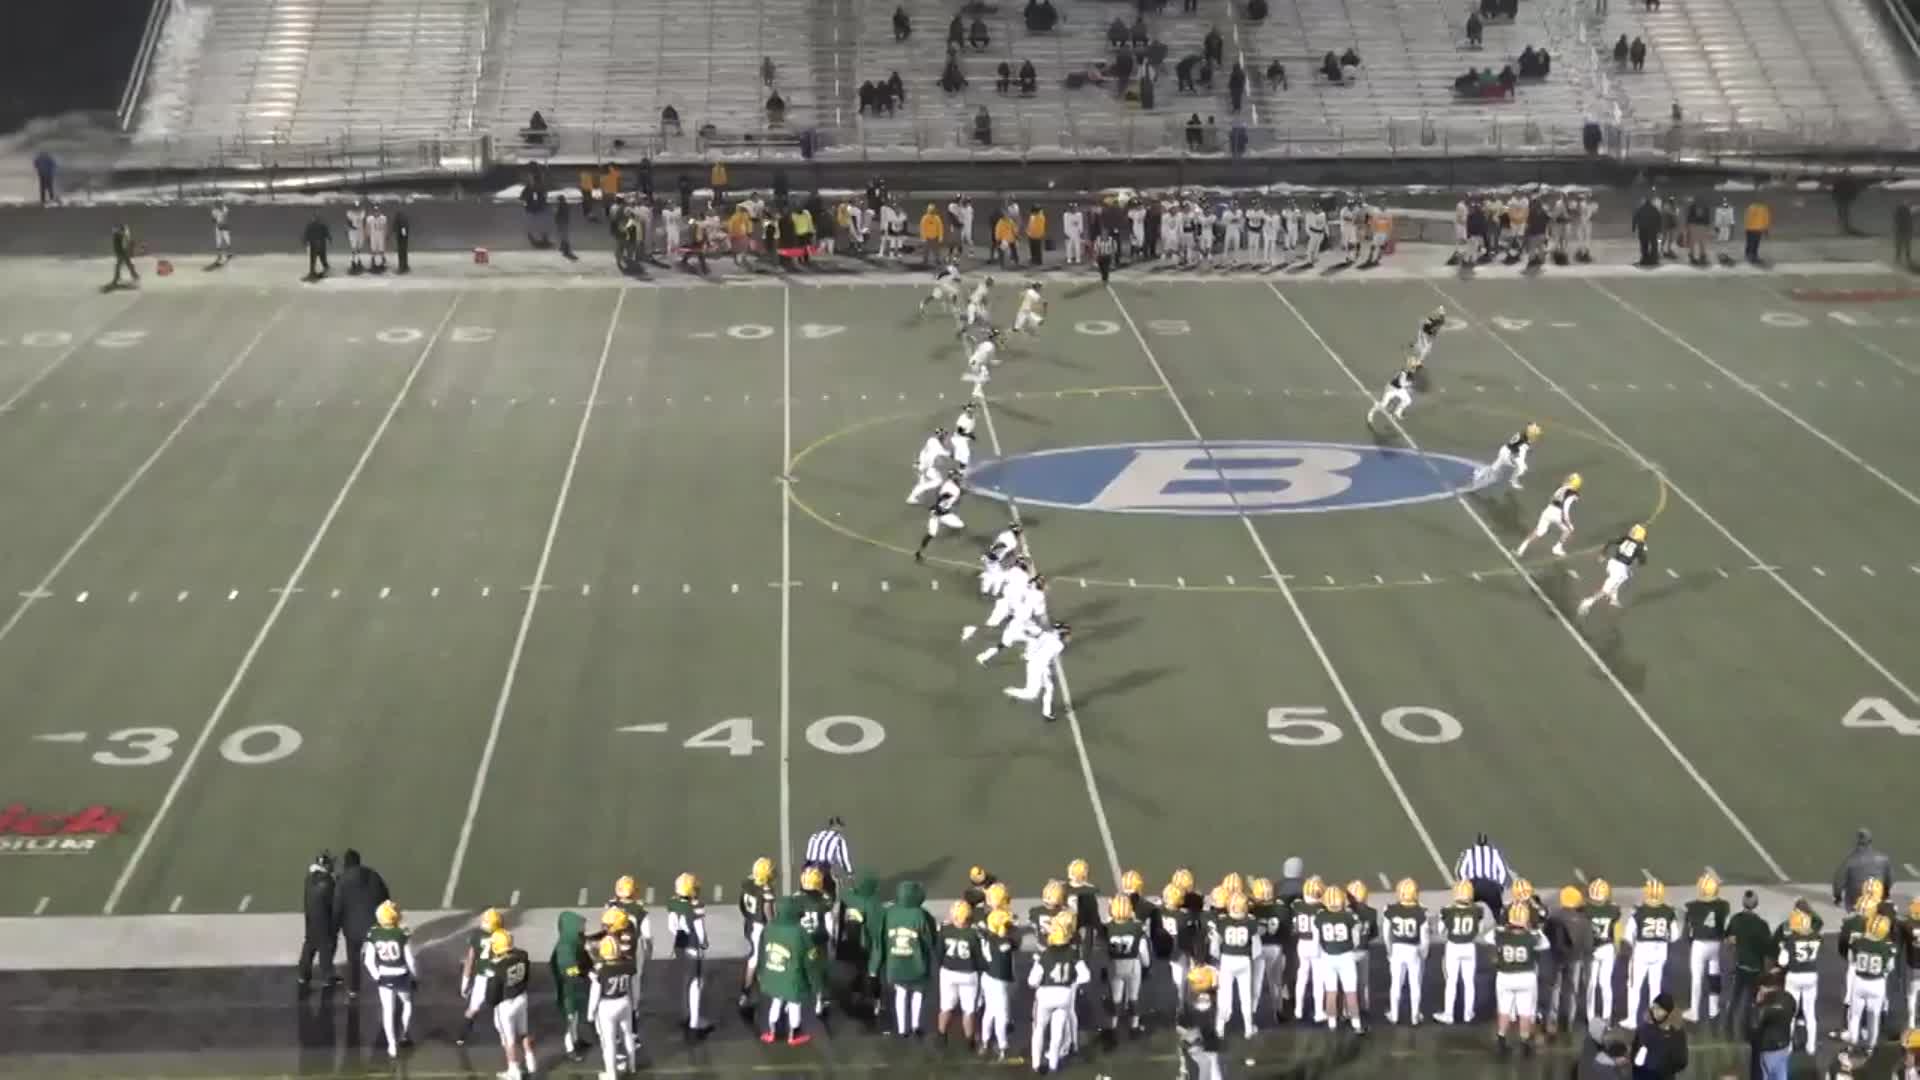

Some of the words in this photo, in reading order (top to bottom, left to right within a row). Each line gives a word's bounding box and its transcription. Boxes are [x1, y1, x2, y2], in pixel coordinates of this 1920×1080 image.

[1089, 447, 1363, 511] B
[682, 715, 887, 756] 40
[1265, 705, 1464, 746] 50
[91, 723, 304, 766] 30
[1391, 916, 1417, 937] 30
[1451, 916, 1474, 937] 10
[1704, 910, 1717, 928] 4
[1794, 941, 1821, 962] 57
